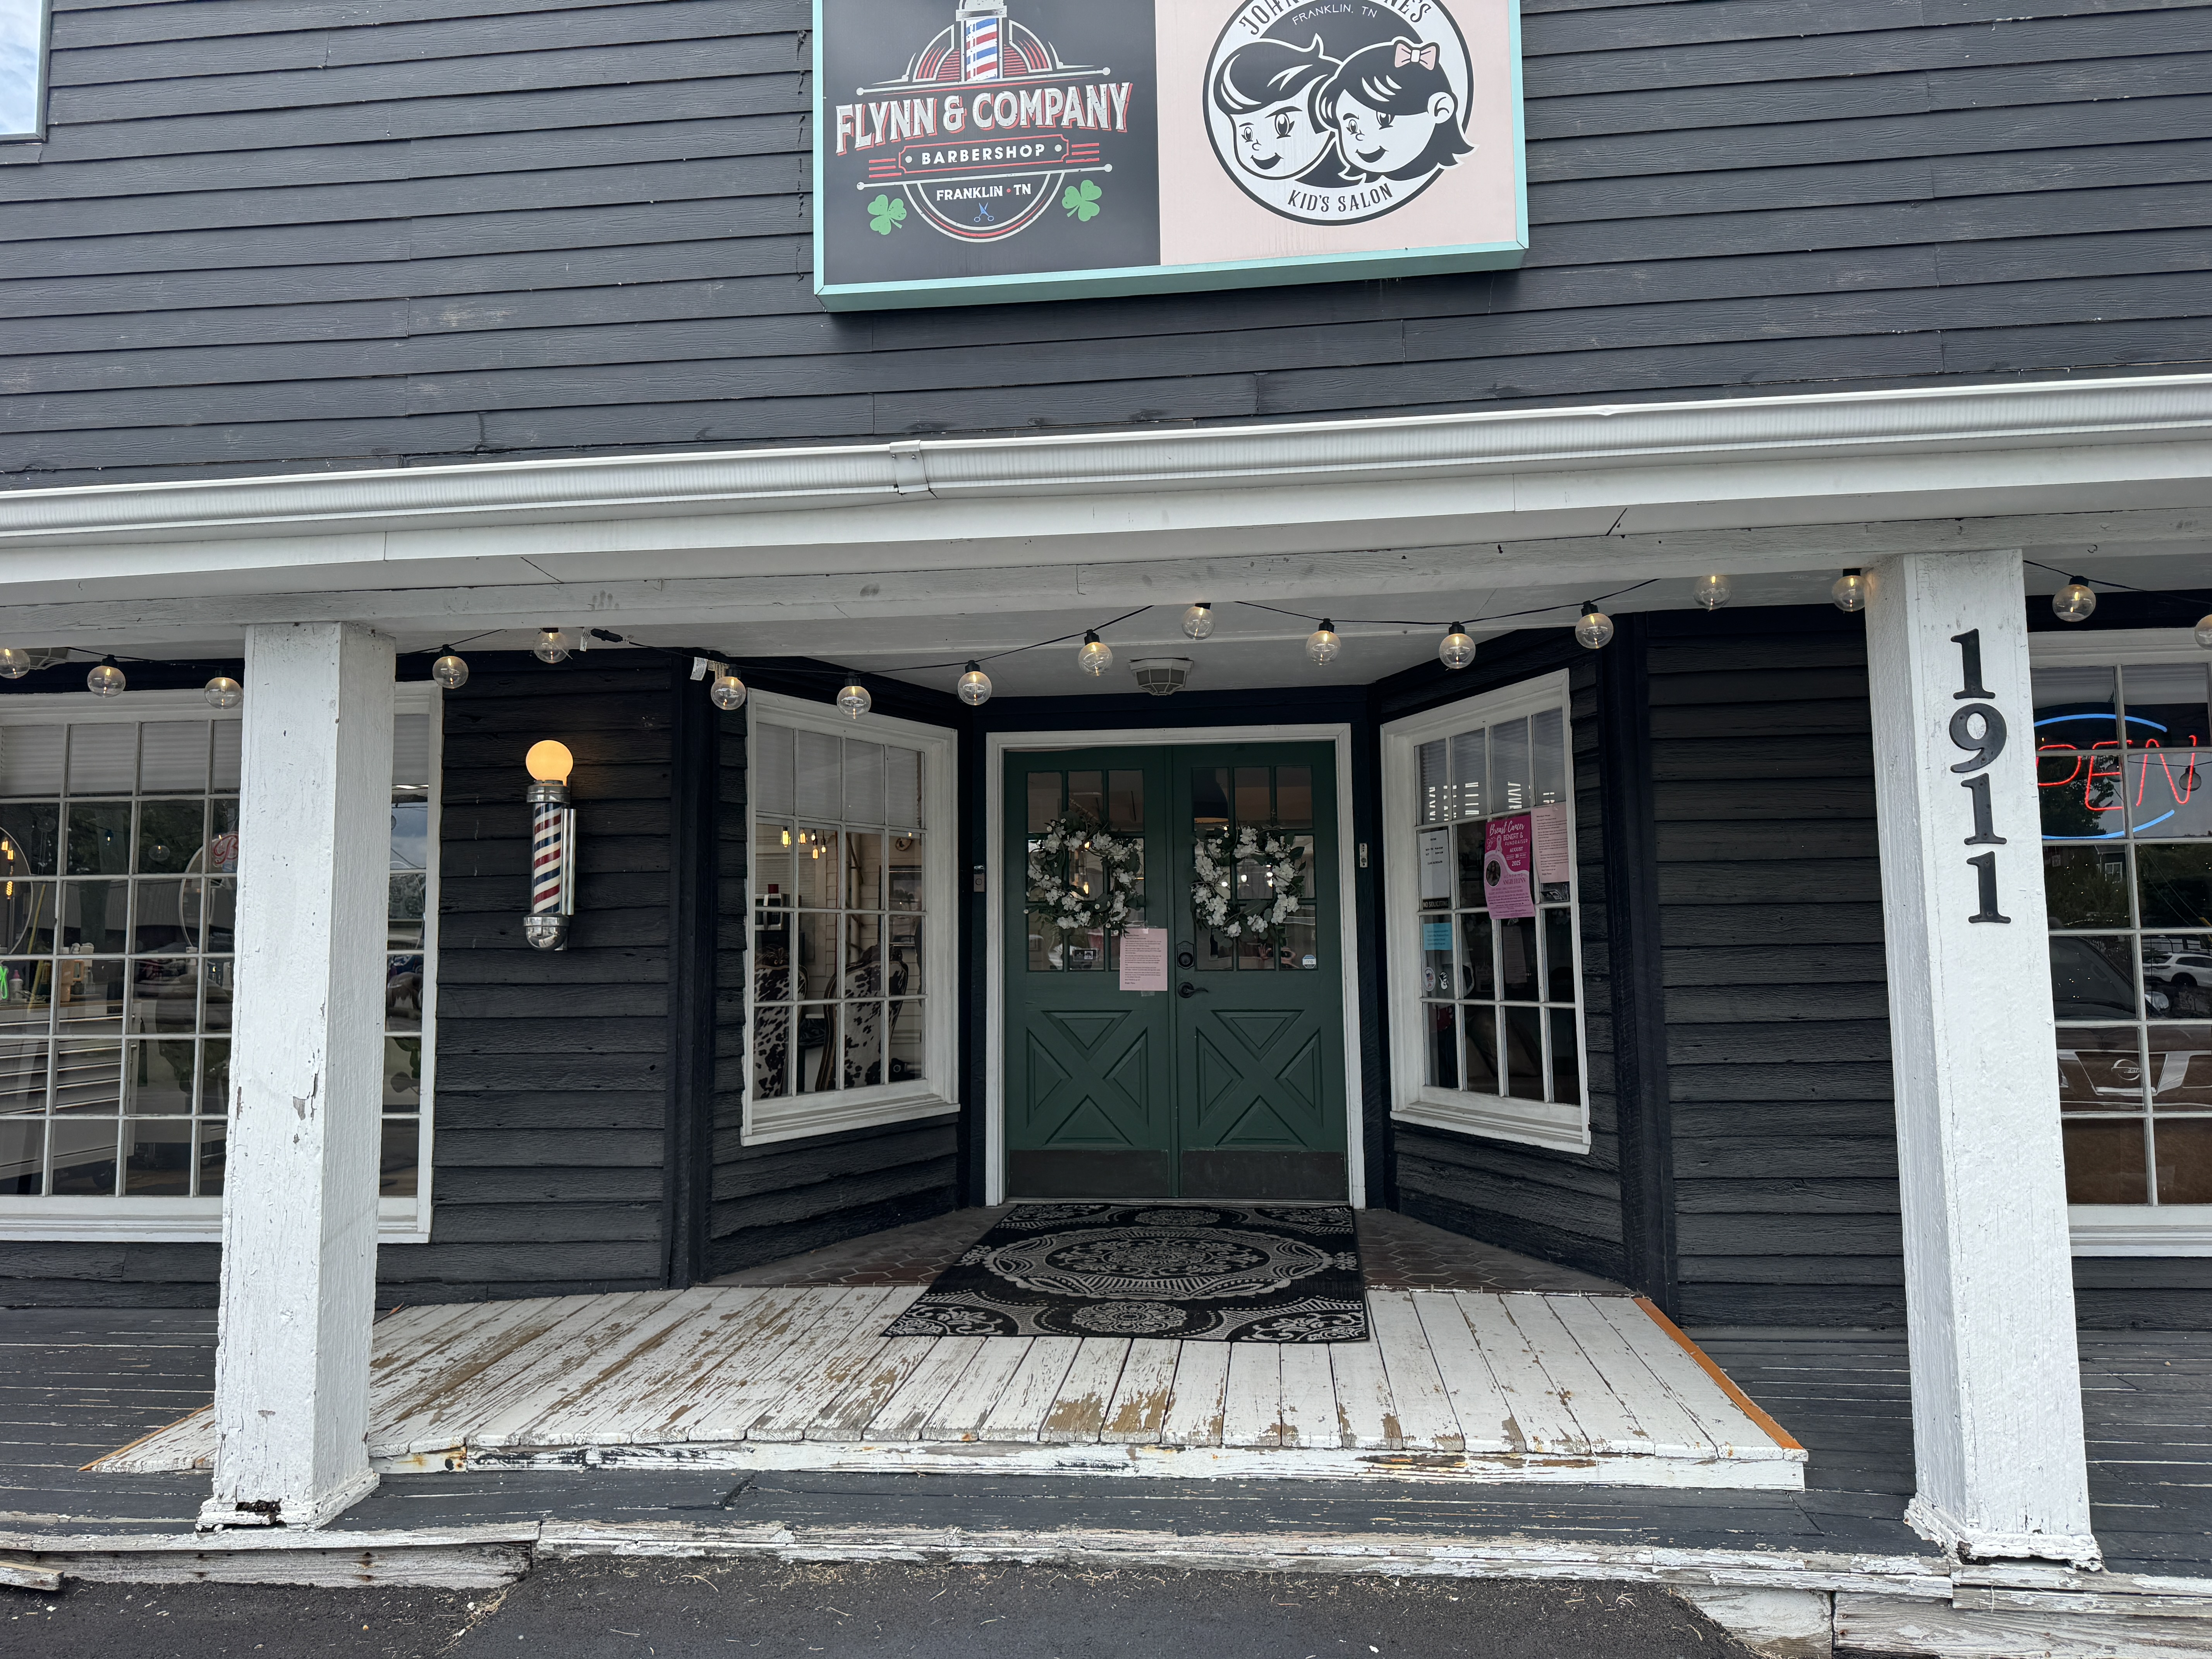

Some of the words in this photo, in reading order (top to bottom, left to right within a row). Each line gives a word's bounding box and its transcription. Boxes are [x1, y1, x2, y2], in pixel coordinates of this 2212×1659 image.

[1362, 6, 1377, 18] TN
[835, 97, 938, 156] FLYNN
[943, 95, 967, 133] &
[973, 82, 1134, 132] COMPANY
[921, 143, 1046, 165] BARBERSHOP
[936, 185, 1003, 201] FRANKLIN
[1013, 183, 1031, 196] TN
[1287, 189, 1330, 213] KID'S
[1338, 182, 1393, 212] SALON
[1949, 628, 2011, 924] 1911
[2036, 735, 2197, 811] PEN
[1490, 821, 1507, 836] Breast
[1508, 821, 1525, 833] Cancer
[1503, 833, 1519, 841] BENEFIT
